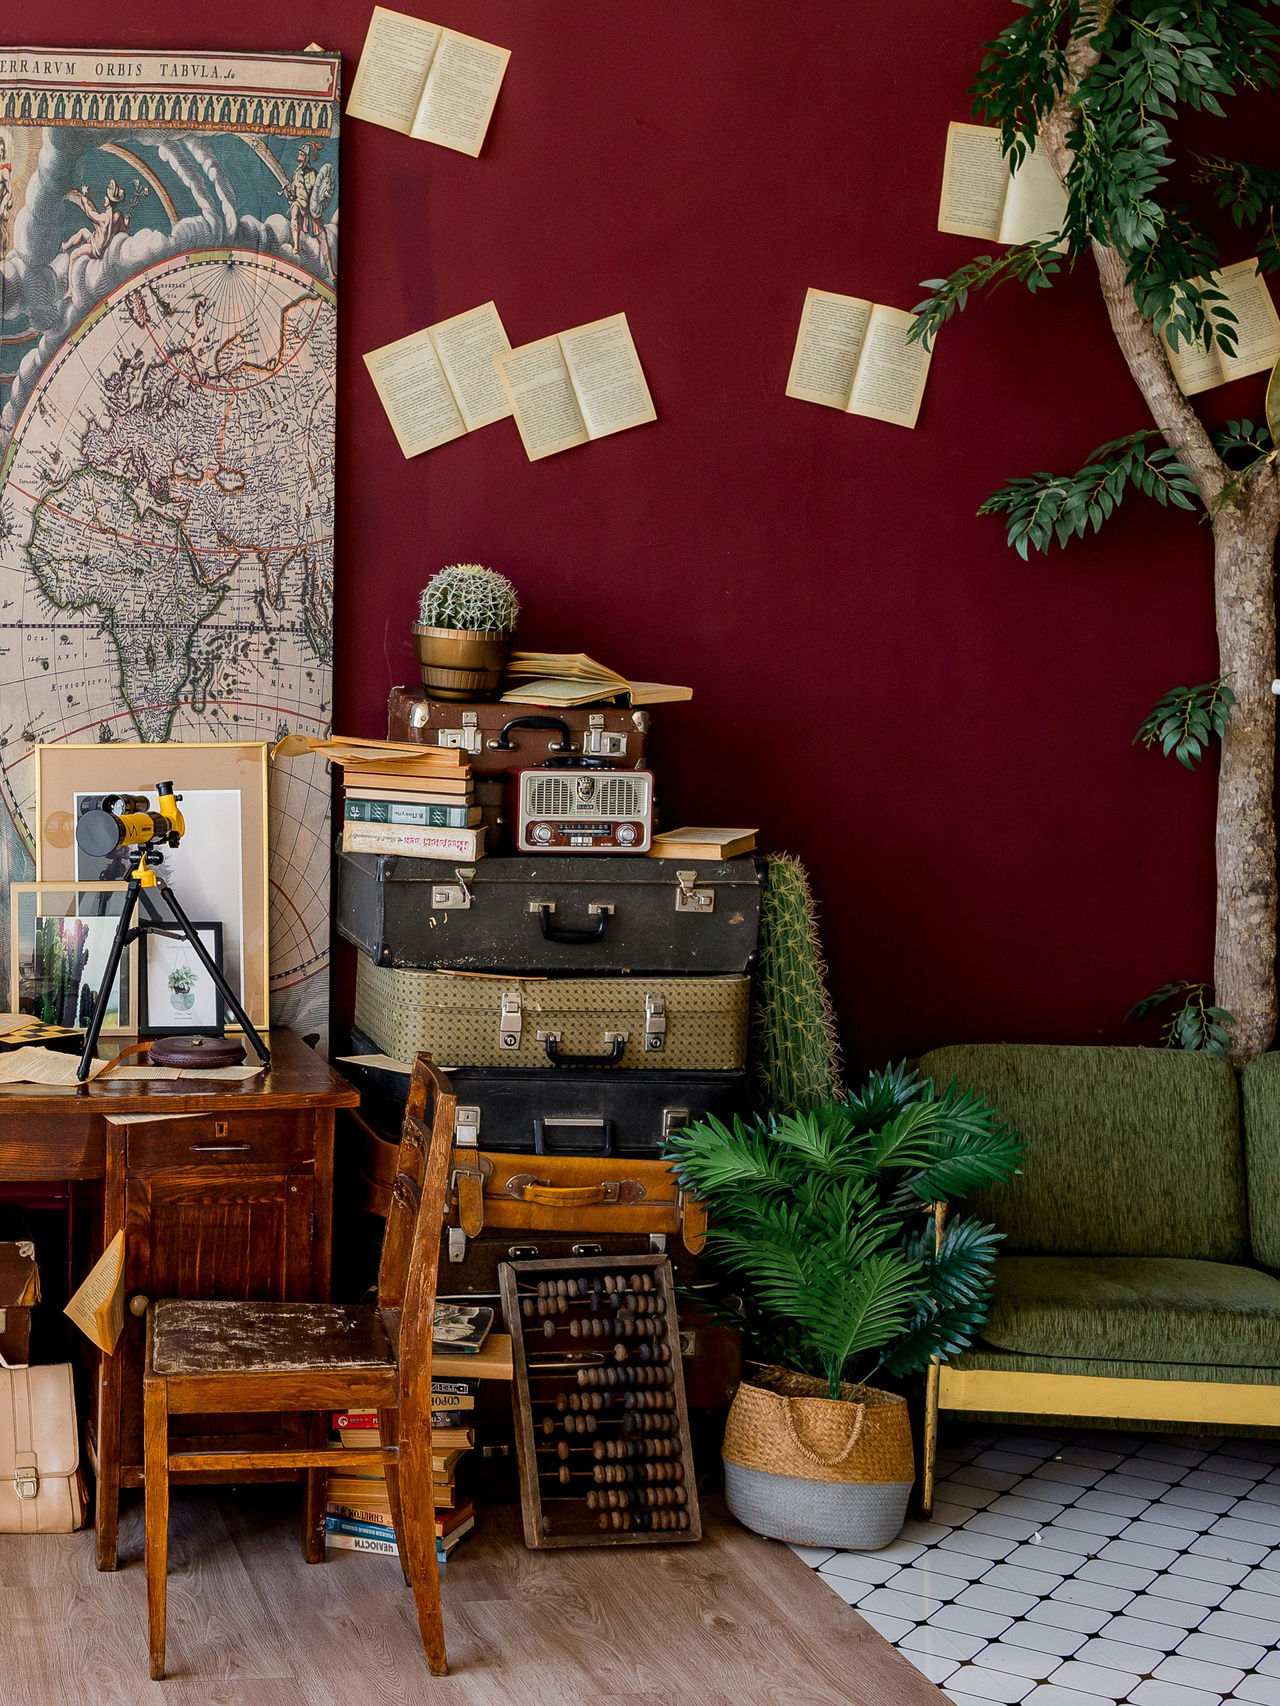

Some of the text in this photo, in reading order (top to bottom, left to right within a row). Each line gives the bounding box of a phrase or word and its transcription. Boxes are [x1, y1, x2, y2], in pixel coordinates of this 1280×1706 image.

[95, 63, 143, 77] ORBIS
[349, 1508, 384, 1523] КОЛЛИНЗ
[354, 1539, 394, 1553] ЧЕЛЮСТИ
